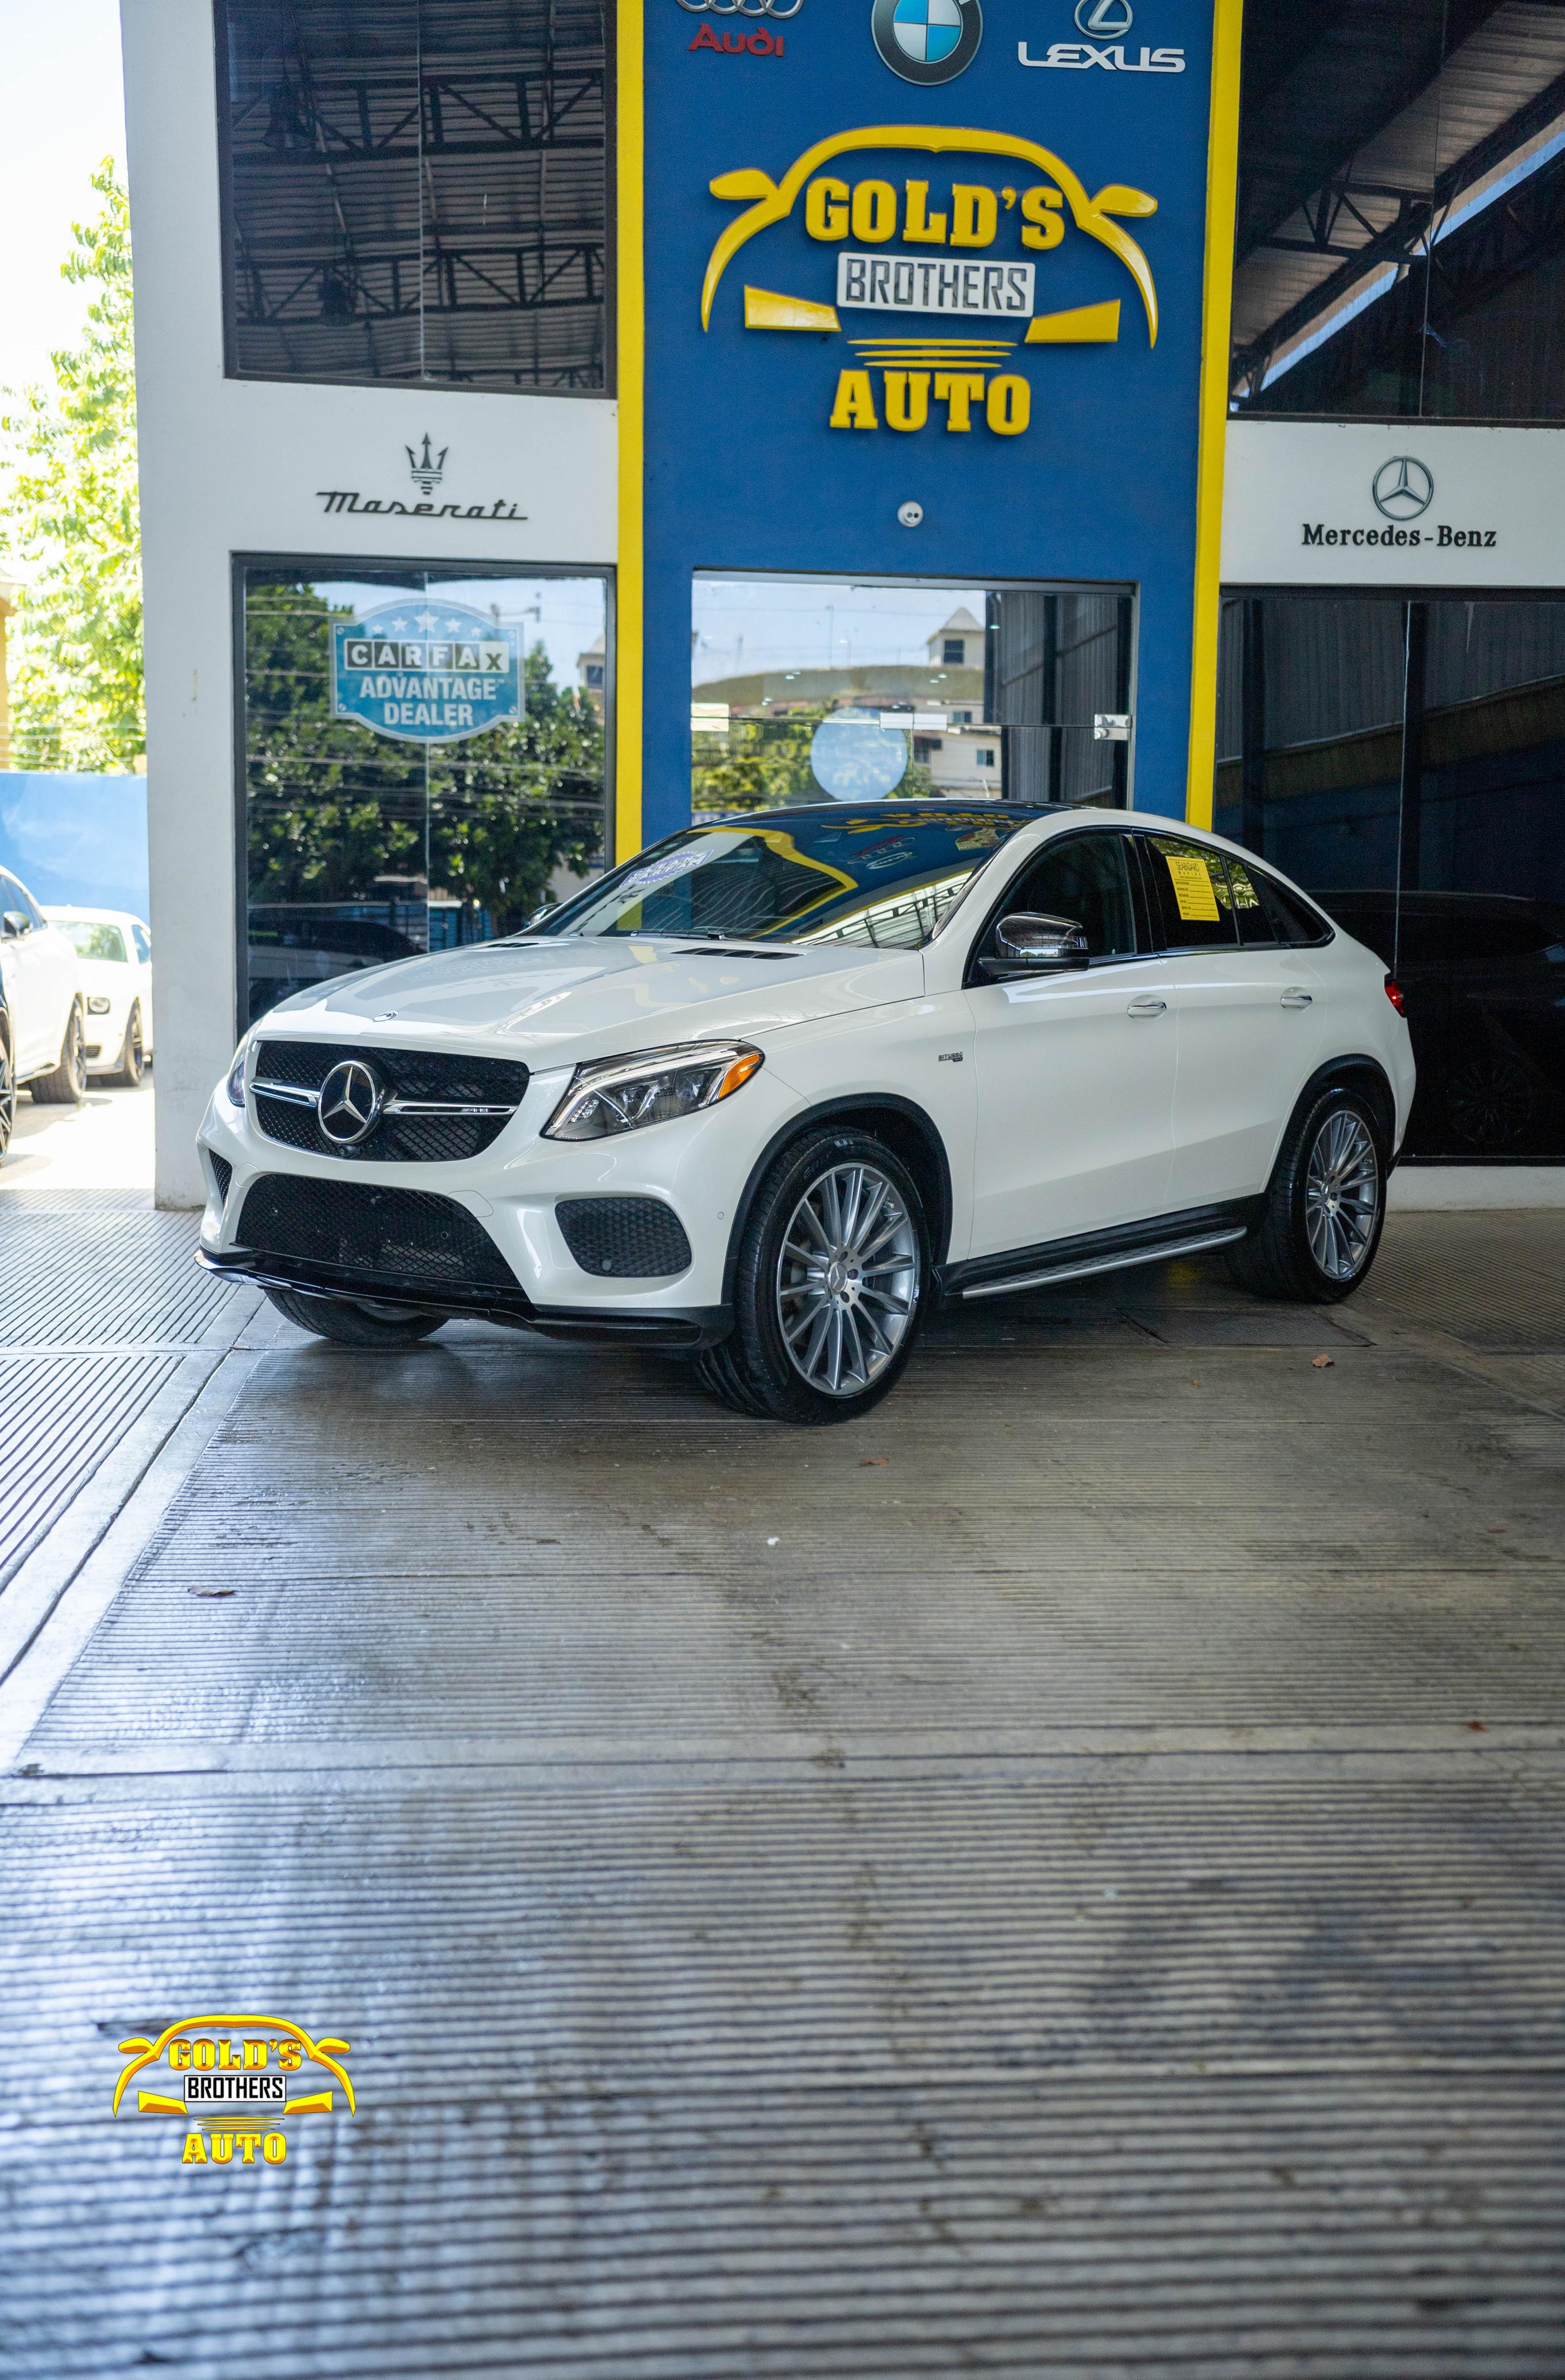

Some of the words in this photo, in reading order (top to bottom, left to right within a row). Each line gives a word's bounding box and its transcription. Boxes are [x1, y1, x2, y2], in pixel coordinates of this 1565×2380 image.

[688, 23, 785, 58] Audi
[1019, 41, 1186, 73] LEXUS
[806, 176, 1065, 250] GOLD'S
[845, 258, 1027, 311] BROTHERS
[830, 369, 1031, 436] AUTO
[316, 491, 529, 521] Maserati
[1301, 523, 1497, 547] Mercedes-Benz
[350, 643, 502, 671] CARFAX
[359, 675, 497, 700] ADVANTAGE
[383, 703, 474, 727] DEALER
[1175, 862, 1200, 871] SEABOARD
